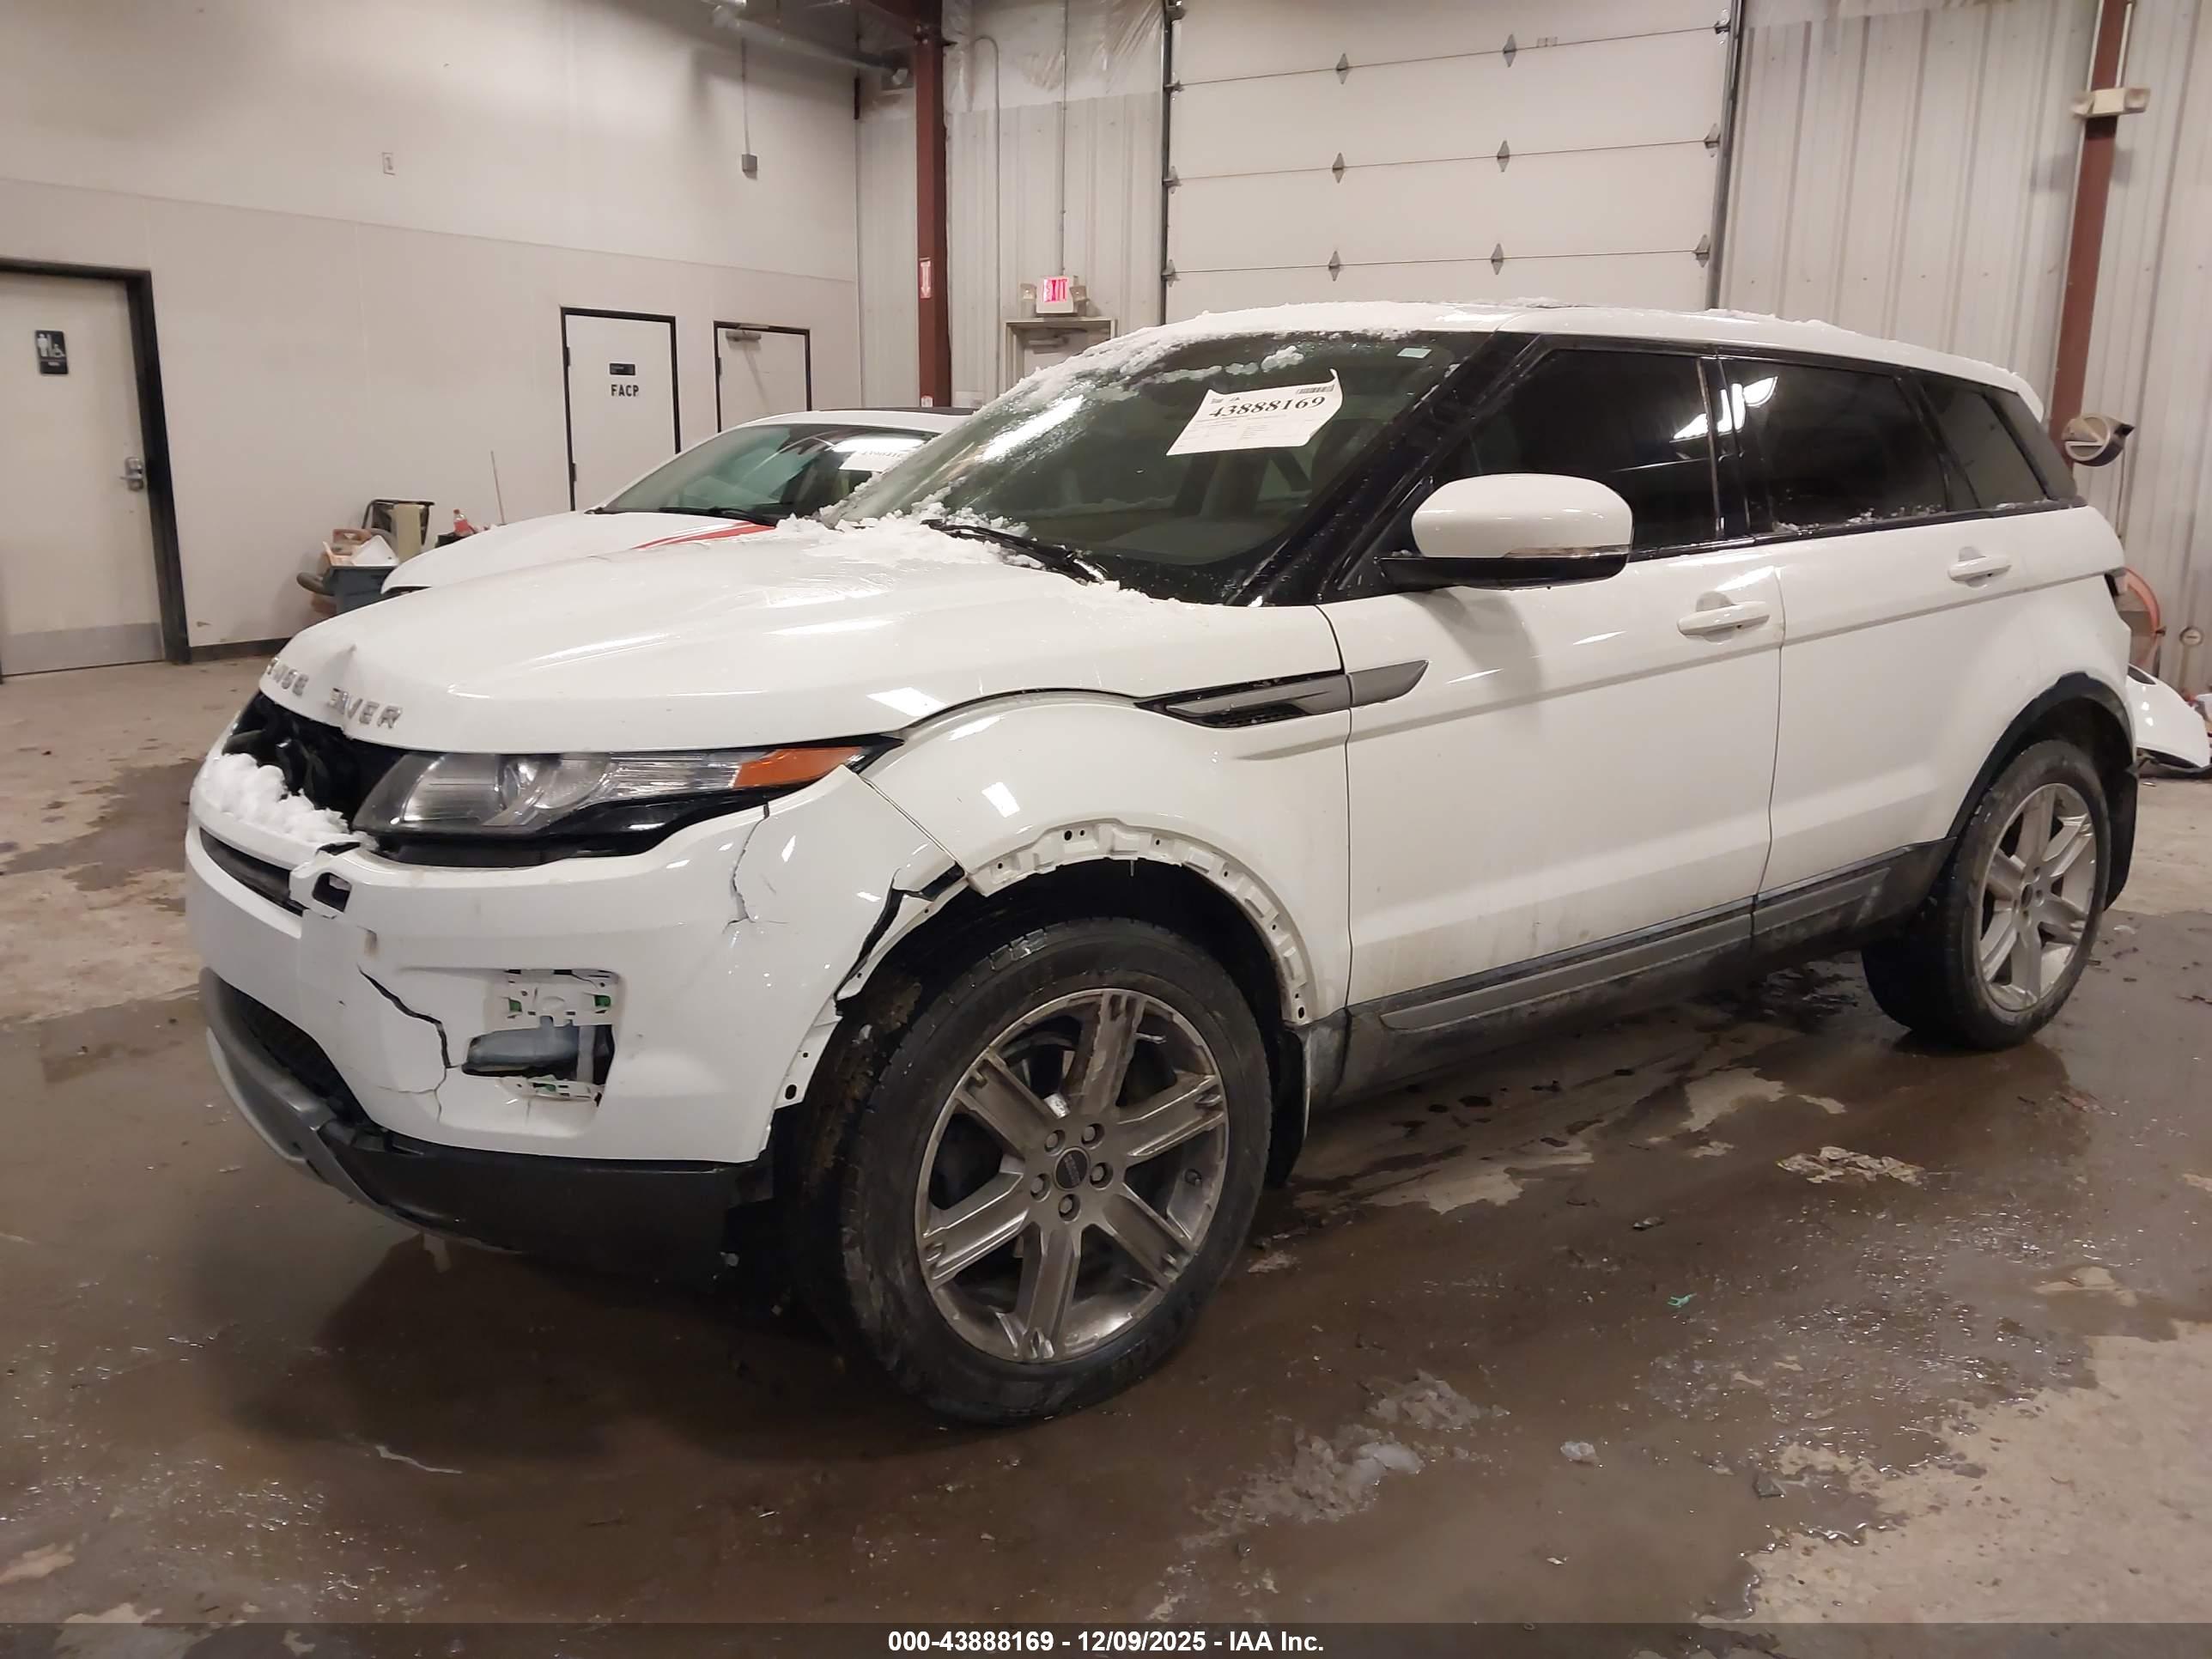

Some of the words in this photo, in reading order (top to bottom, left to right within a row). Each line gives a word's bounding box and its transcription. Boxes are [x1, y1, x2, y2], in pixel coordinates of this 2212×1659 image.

[1043, 277, 1068, 302] EXIT
[611, 384, 640, 397] FACP
[1208, 396, 1326, 418] 43888169
[265, 656, 309, 696] NGE
